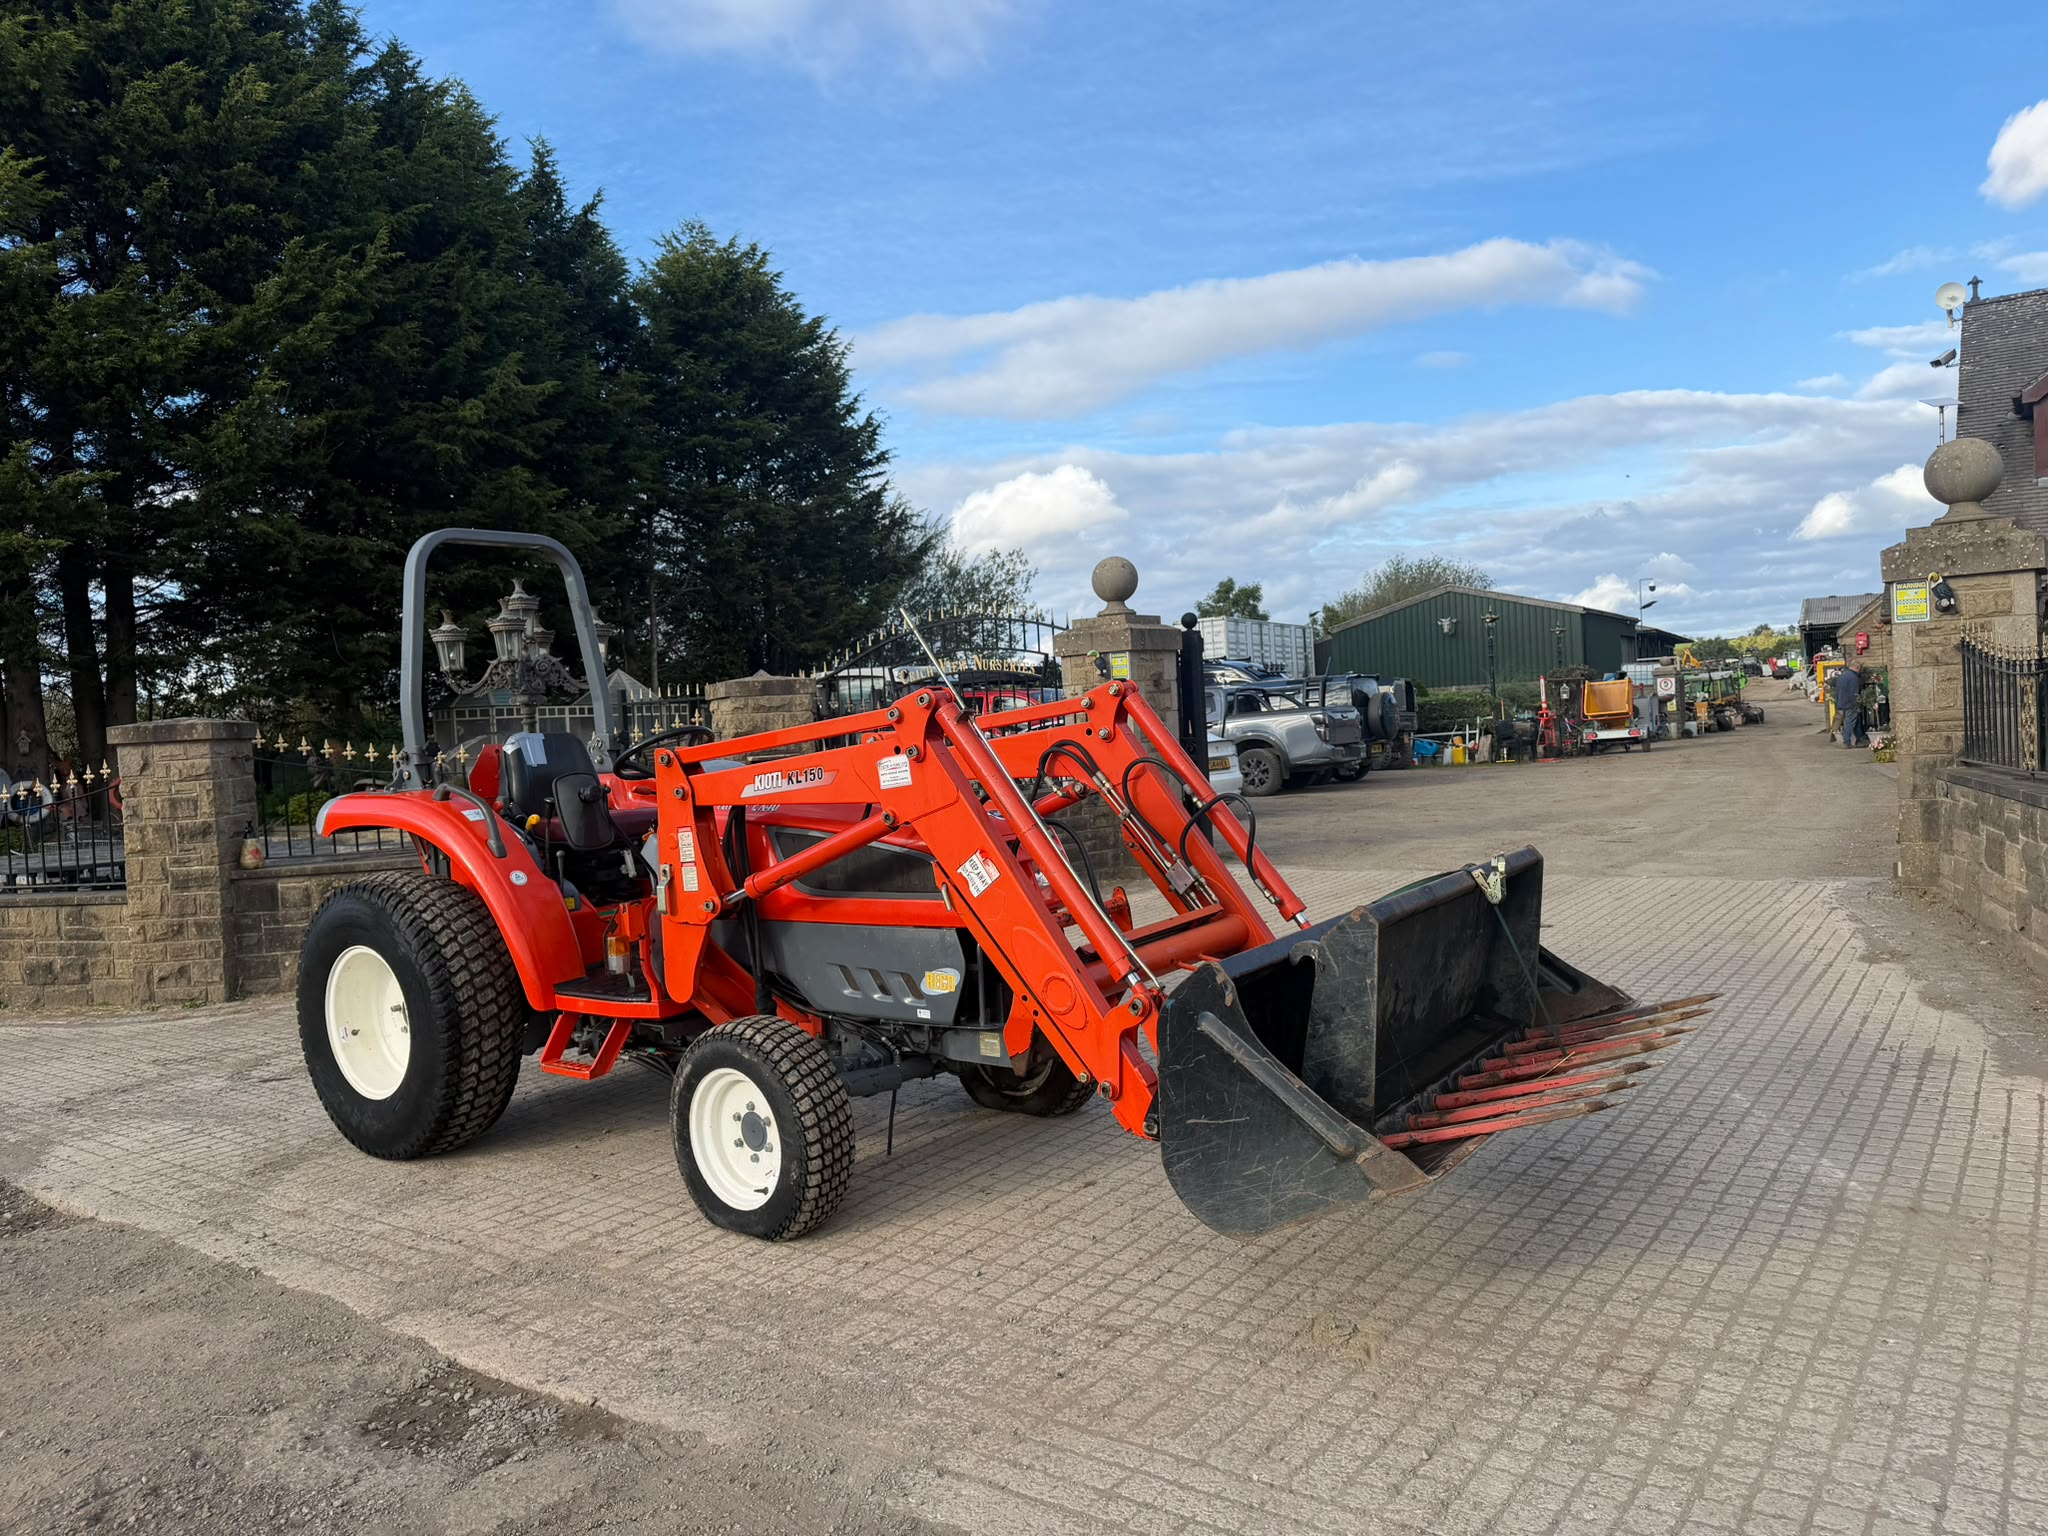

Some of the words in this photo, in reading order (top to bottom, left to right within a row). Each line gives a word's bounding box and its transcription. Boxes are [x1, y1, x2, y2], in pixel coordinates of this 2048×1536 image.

[900, 666, 935, 685] CRICH
[938, 658, 968, 673] VIEW
[973, 654, 1035, 674] NURSERIES
[754, 771, 782, 791] KIOTI
[787, 767, 824, 785] KL150
